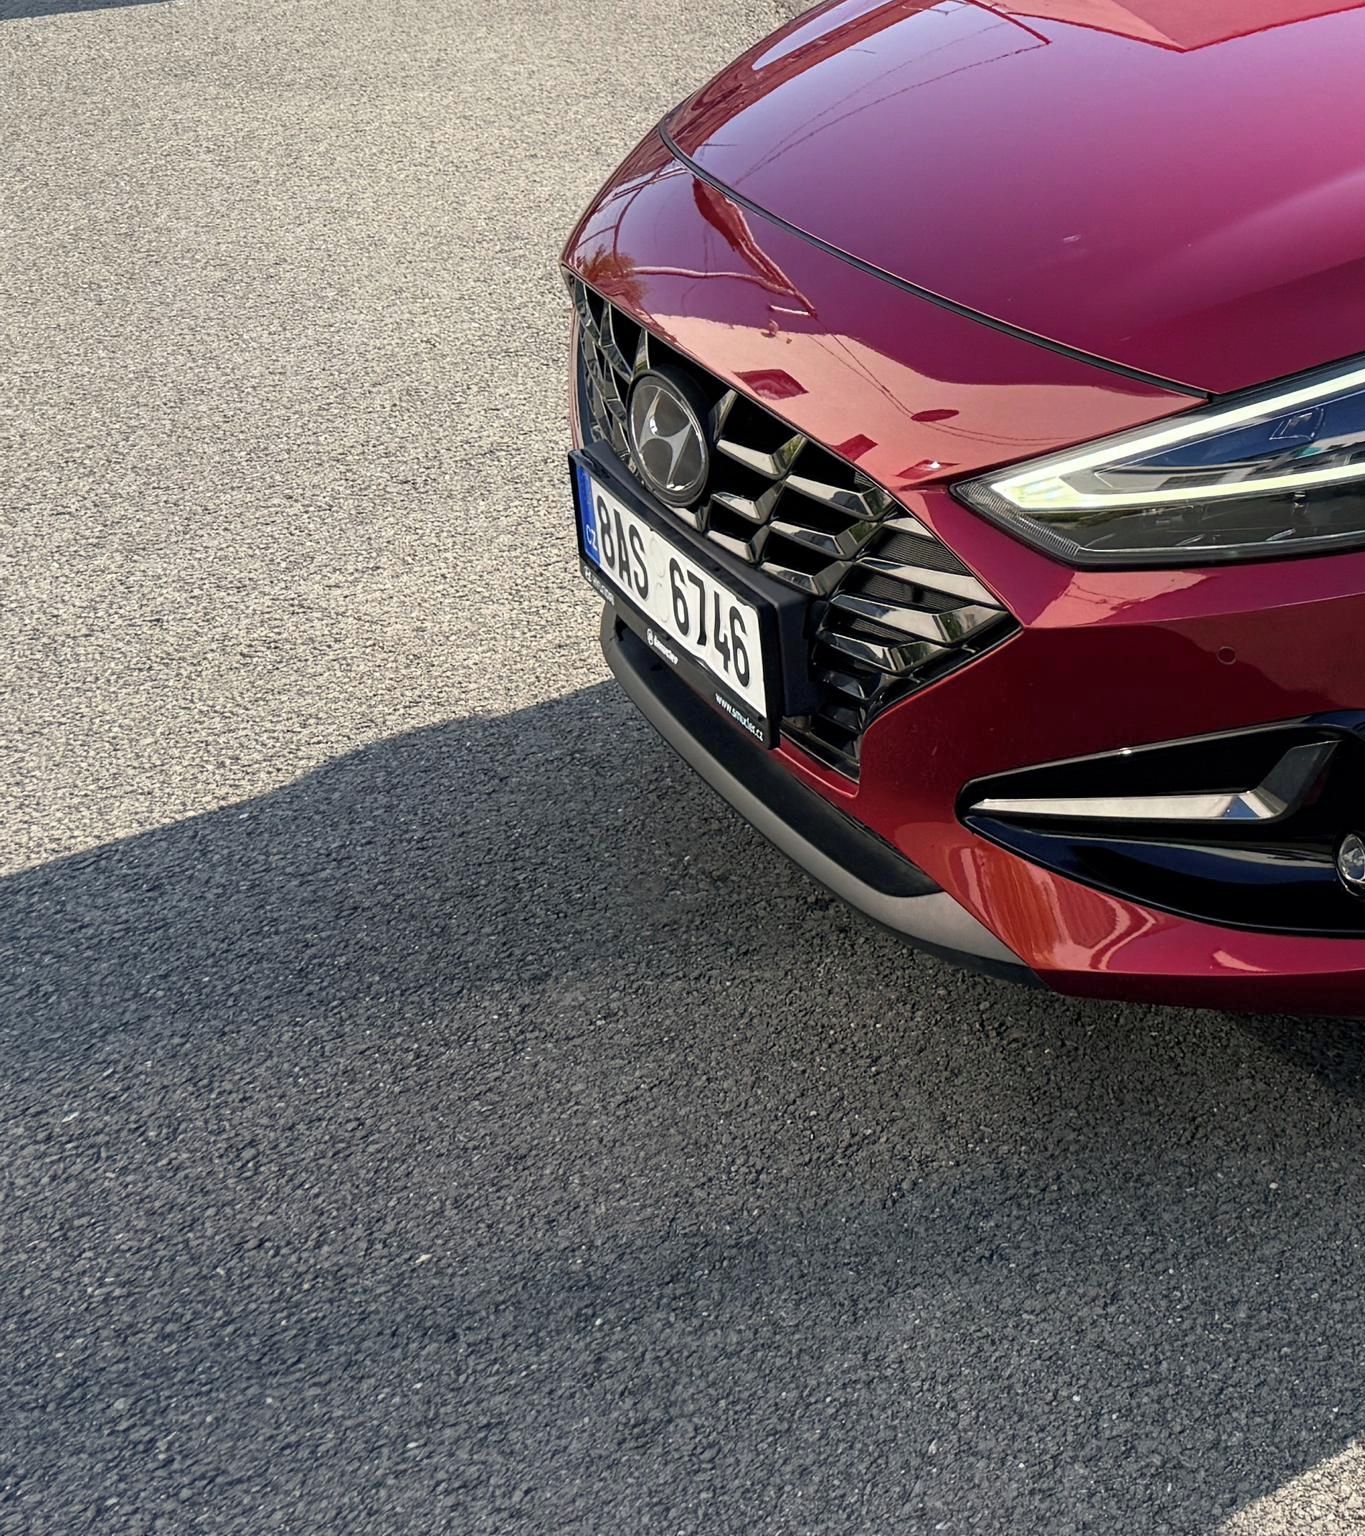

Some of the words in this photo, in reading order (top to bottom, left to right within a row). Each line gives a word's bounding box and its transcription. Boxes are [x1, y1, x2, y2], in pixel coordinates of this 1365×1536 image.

[586, 523, 598, 552] CZ
[596, 494, 649, 601] 8AS
[669, 557, 751, 688] 6746
